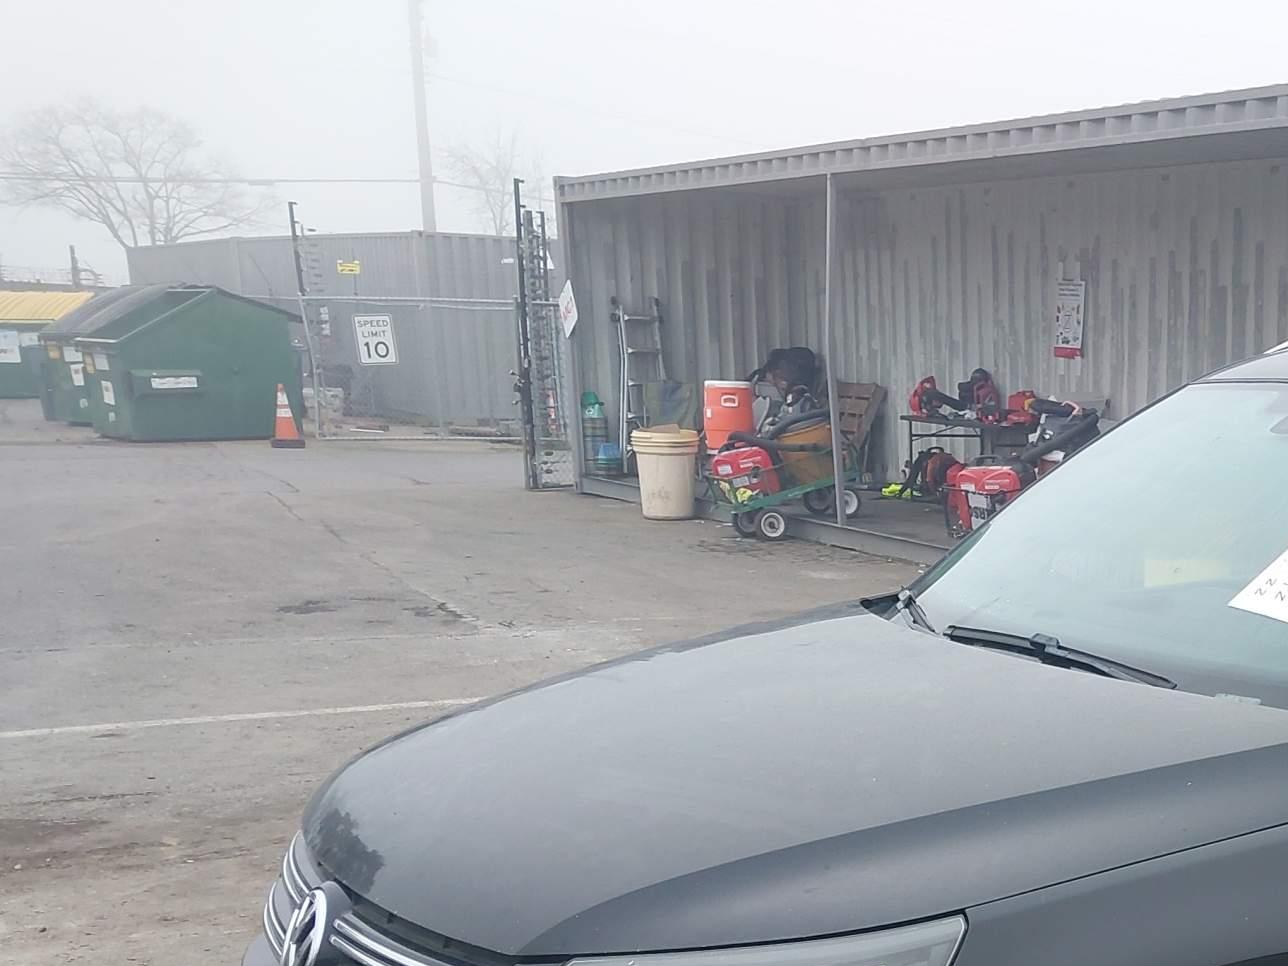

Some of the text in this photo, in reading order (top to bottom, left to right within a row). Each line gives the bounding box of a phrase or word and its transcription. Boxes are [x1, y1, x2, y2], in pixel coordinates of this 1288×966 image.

[357, 319, 389, 328] SPEED
[361, 330, 387, 338] LIMIT
[364, 341, 389, 359] 10
